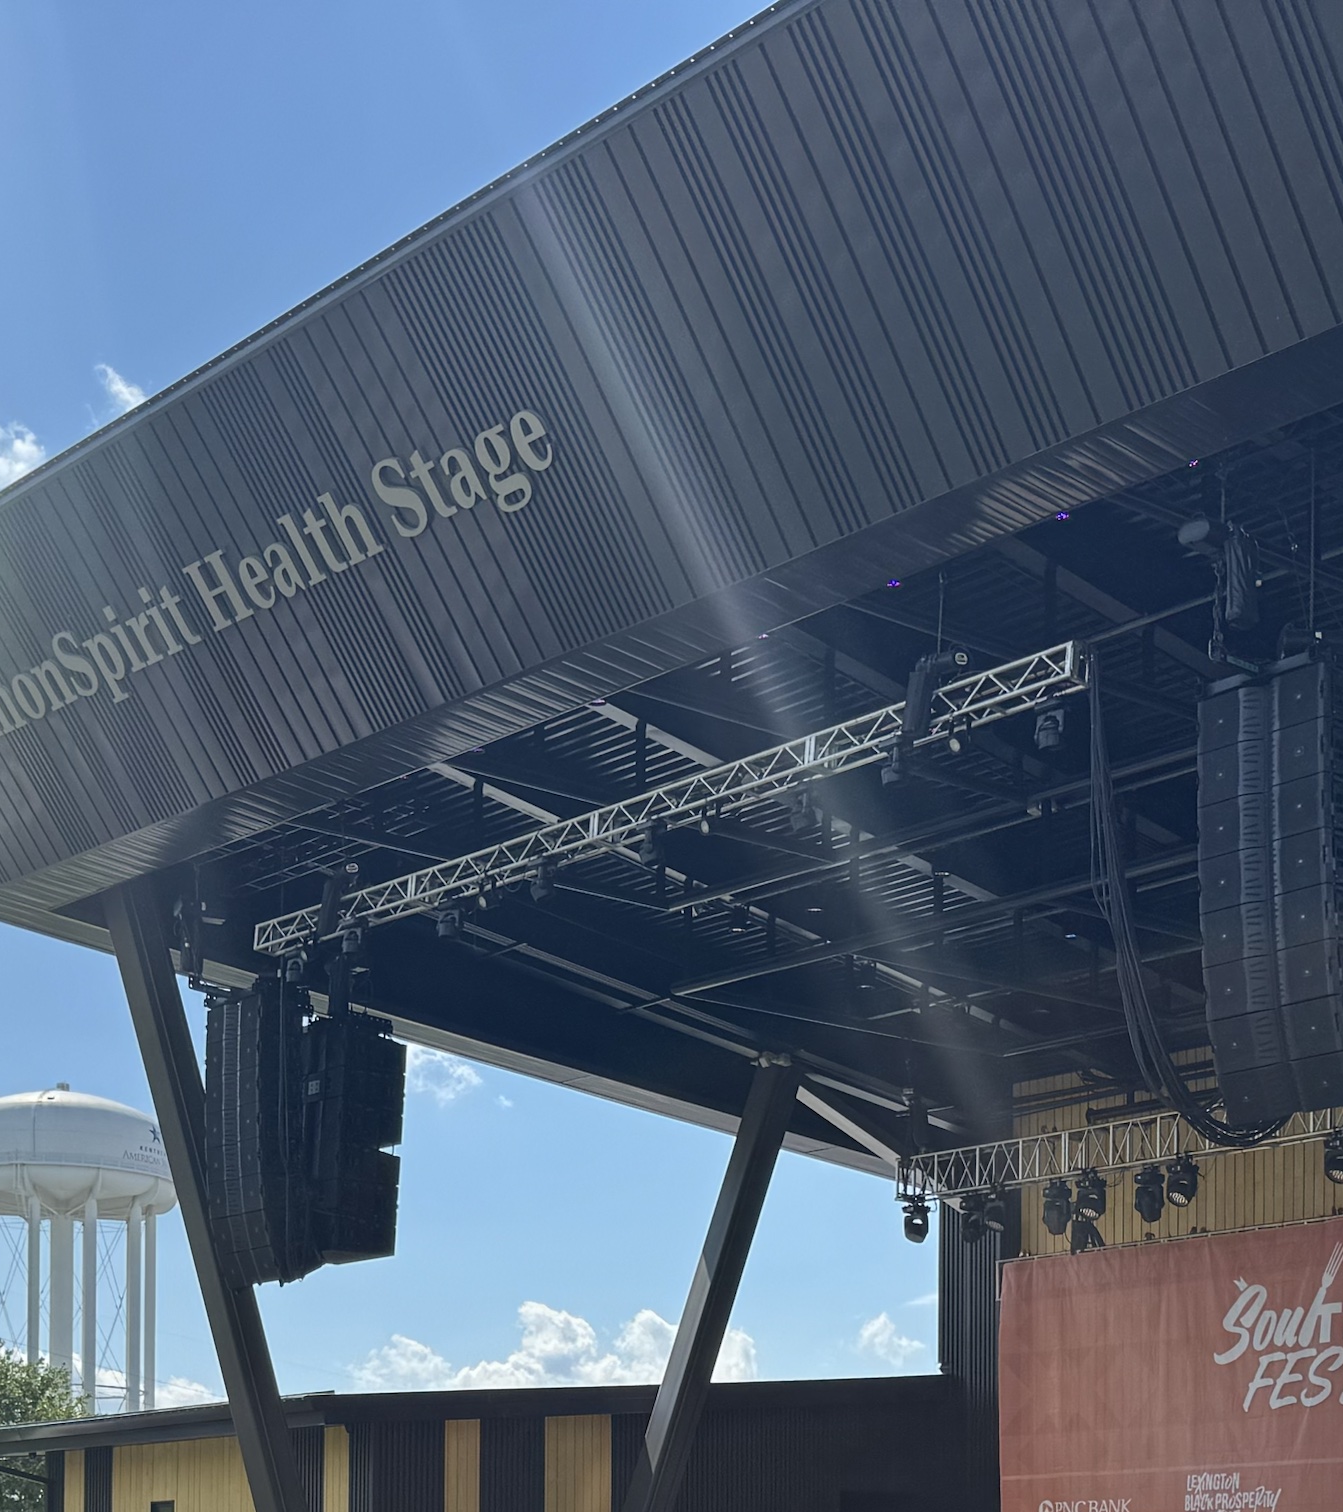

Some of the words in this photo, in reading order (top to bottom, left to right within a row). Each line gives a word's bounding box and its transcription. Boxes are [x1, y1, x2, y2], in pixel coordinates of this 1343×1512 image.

[182, 492, 384, 632] Health
[371, 410, 554, 538] Stage
[1186, 1472, 1240, 1496] LEXINGTON
[1184, 1493, 1214, 1512] BLACK
